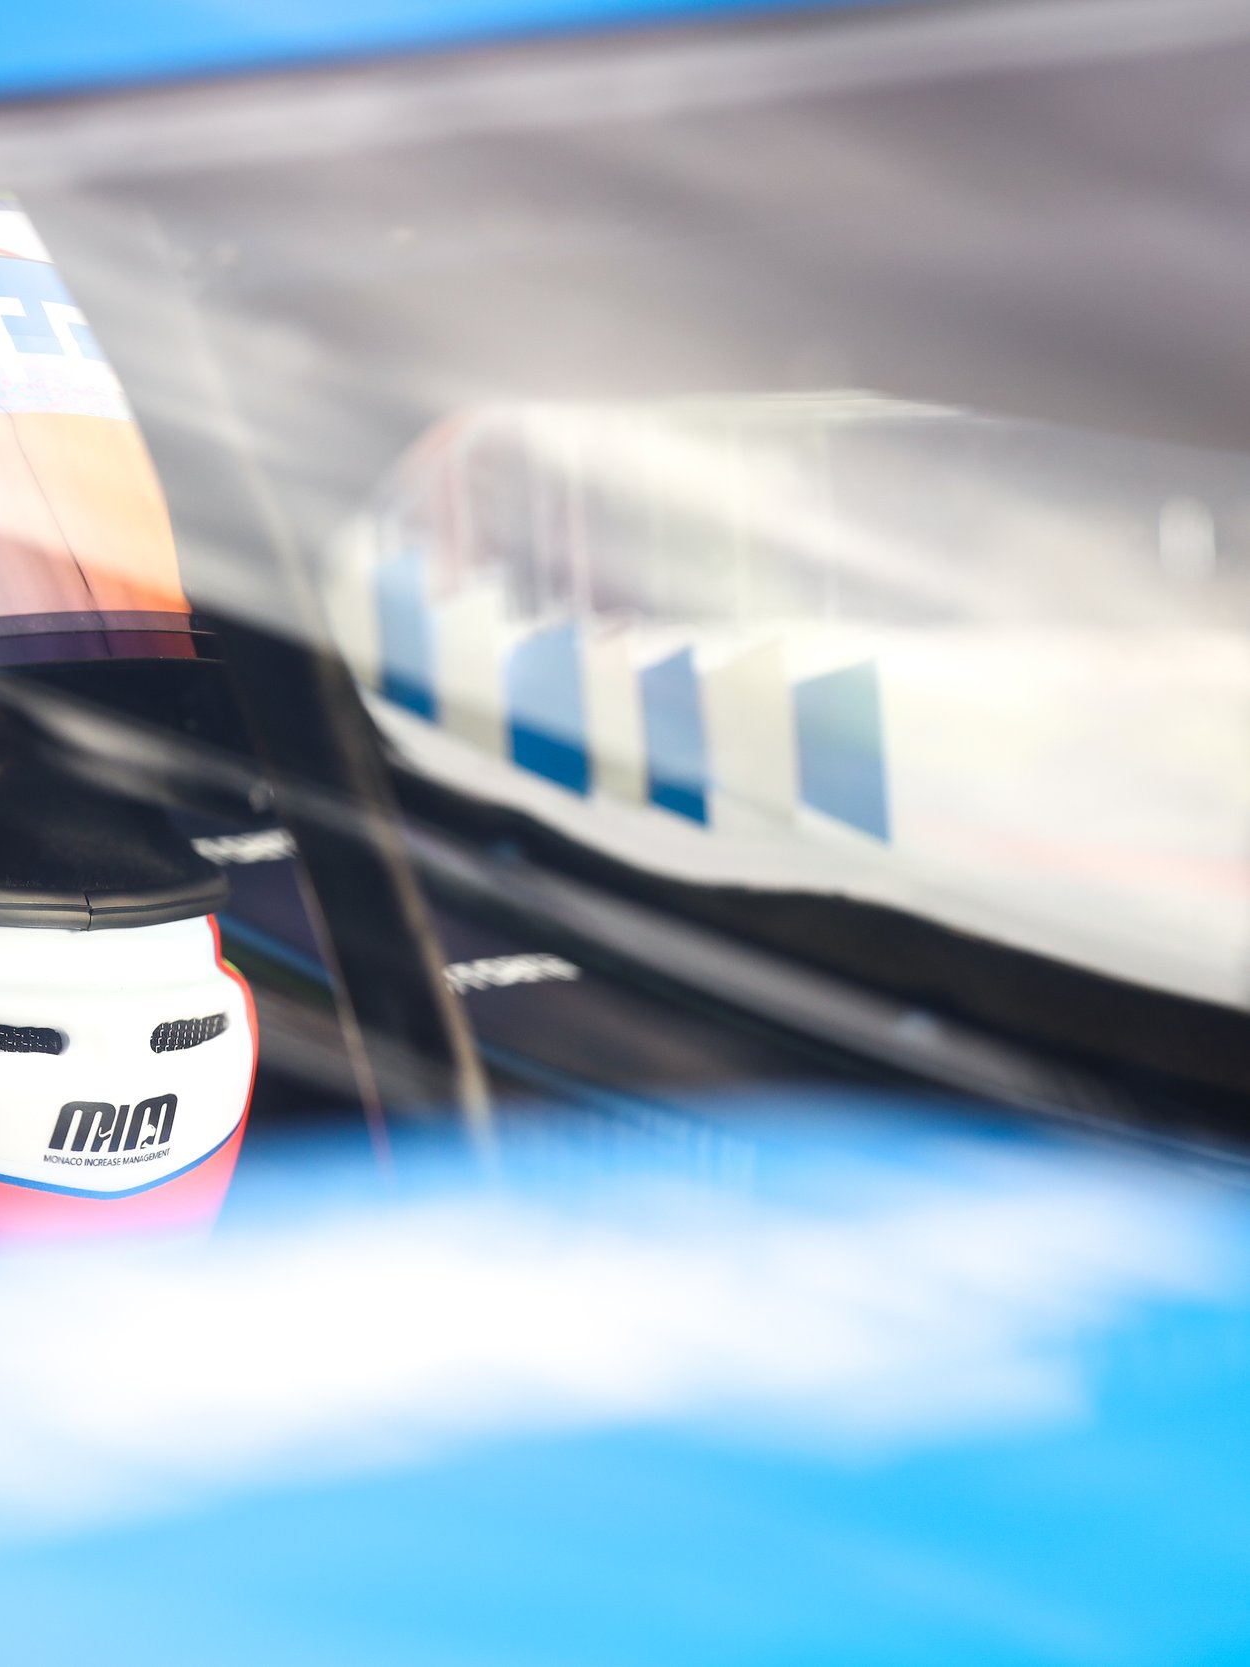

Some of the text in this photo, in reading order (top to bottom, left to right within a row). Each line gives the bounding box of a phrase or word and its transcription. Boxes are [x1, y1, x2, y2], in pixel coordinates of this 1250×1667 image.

[43, 1147, 171, 1167] MONACO INCREASE MANAGEMENT
